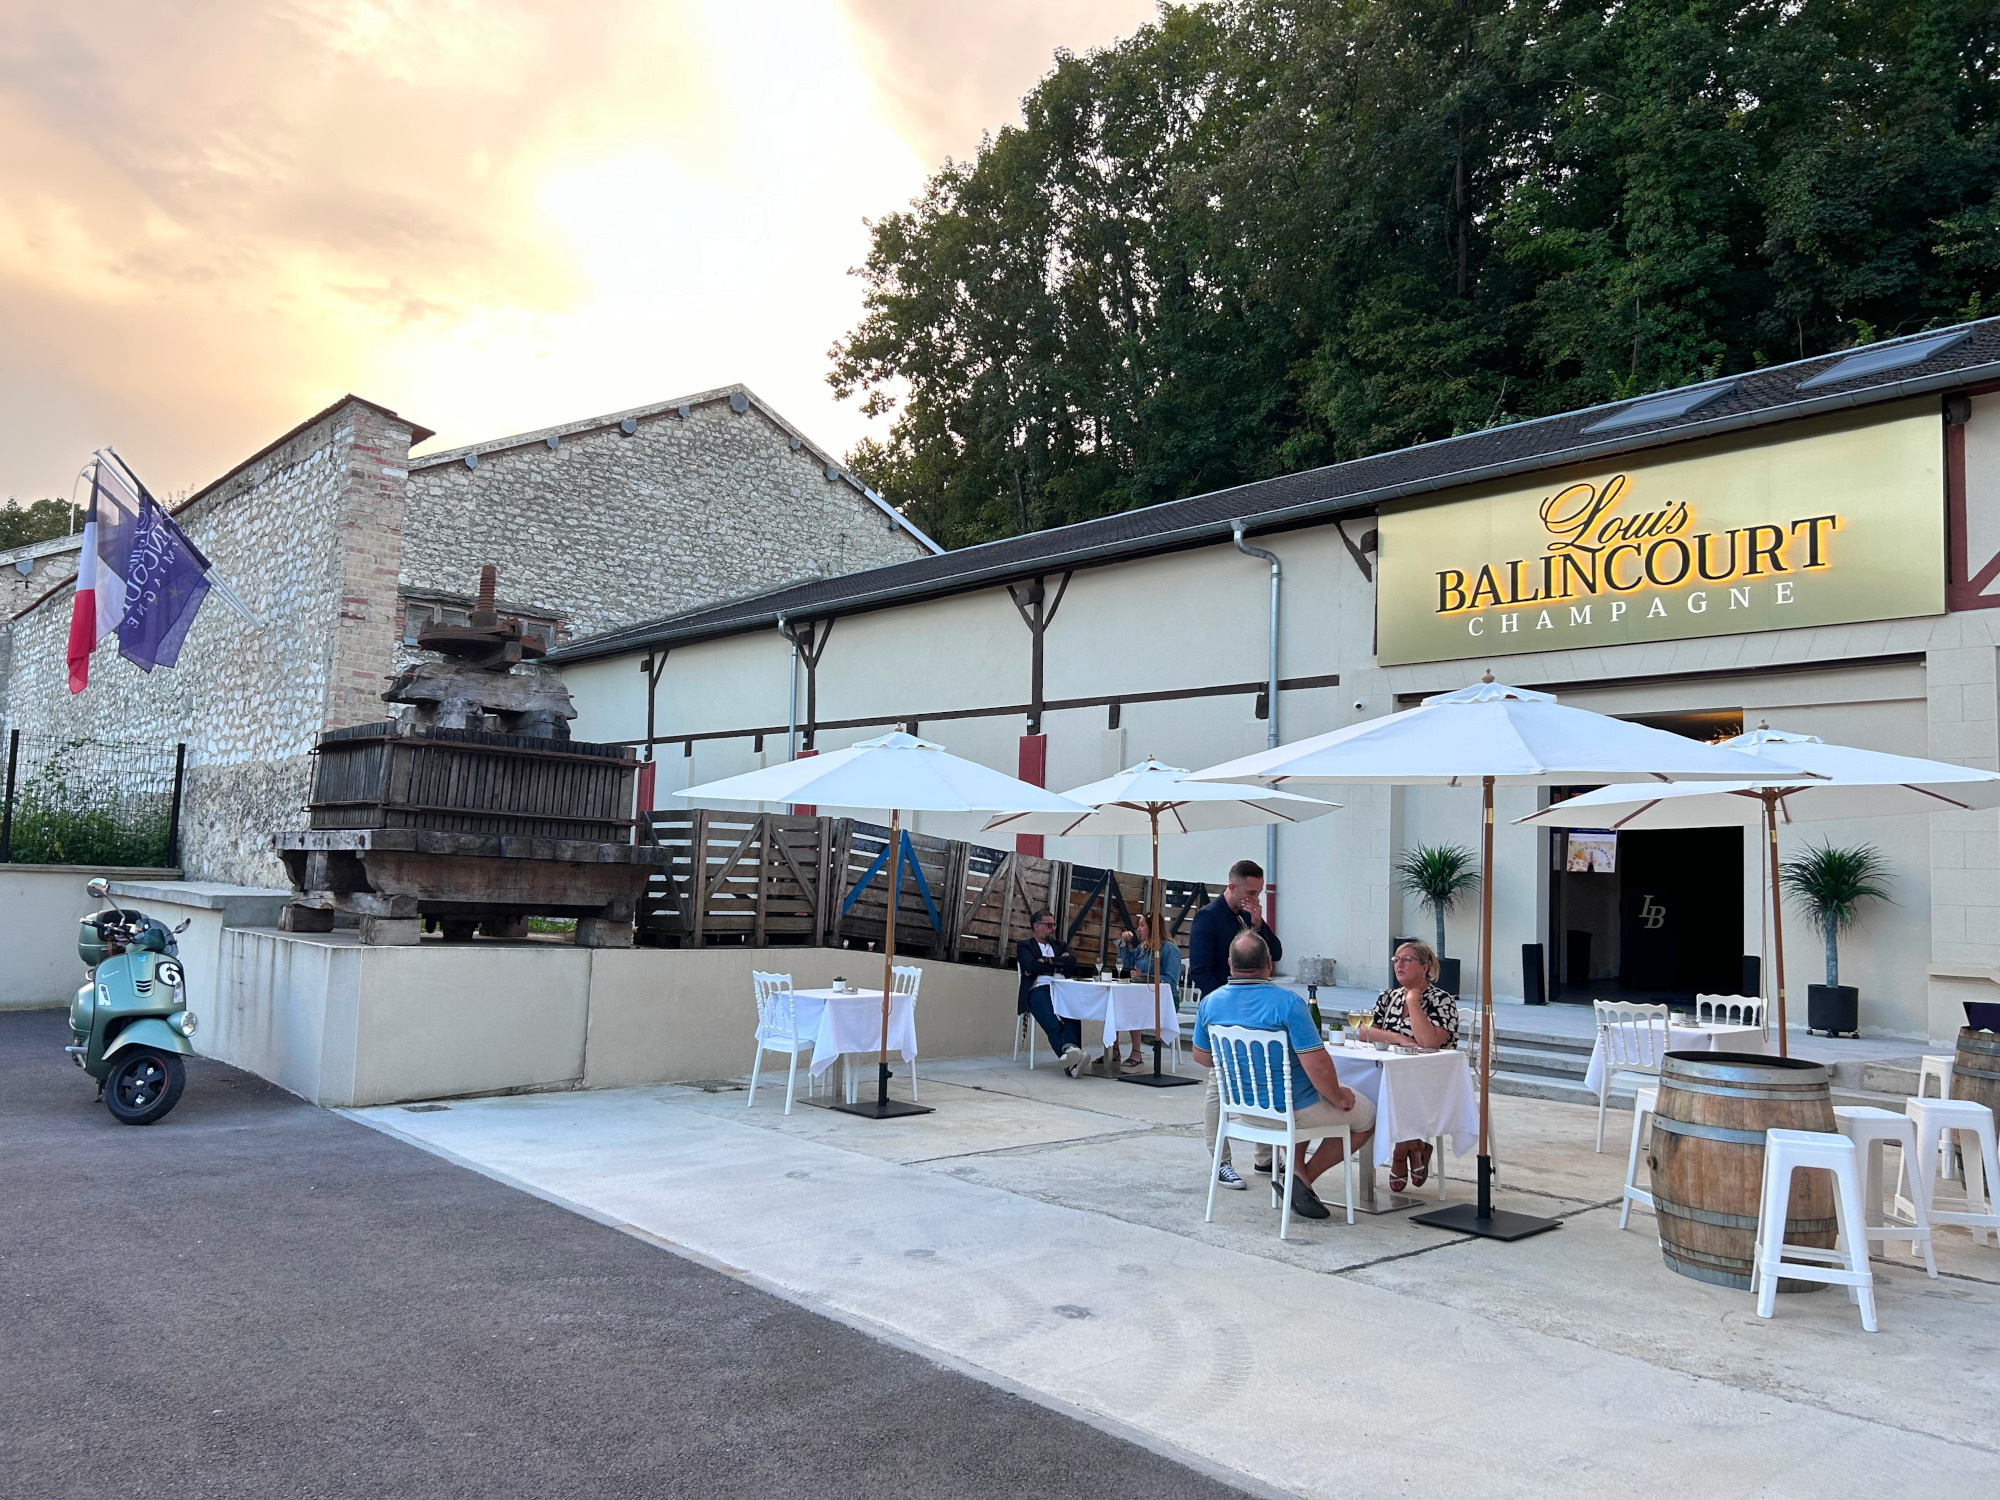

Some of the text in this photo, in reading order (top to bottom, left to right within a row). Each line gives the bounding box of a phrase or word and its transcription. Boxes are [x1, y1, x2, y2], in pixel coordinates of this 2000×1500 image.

[1539, 474, 1688, 551] Louis
[1435, 515, 1837, 613] BALINCOURT
[1467, 581, 1795, 637] CHAMPAGNE
[159, 963, 181, 985] 6
